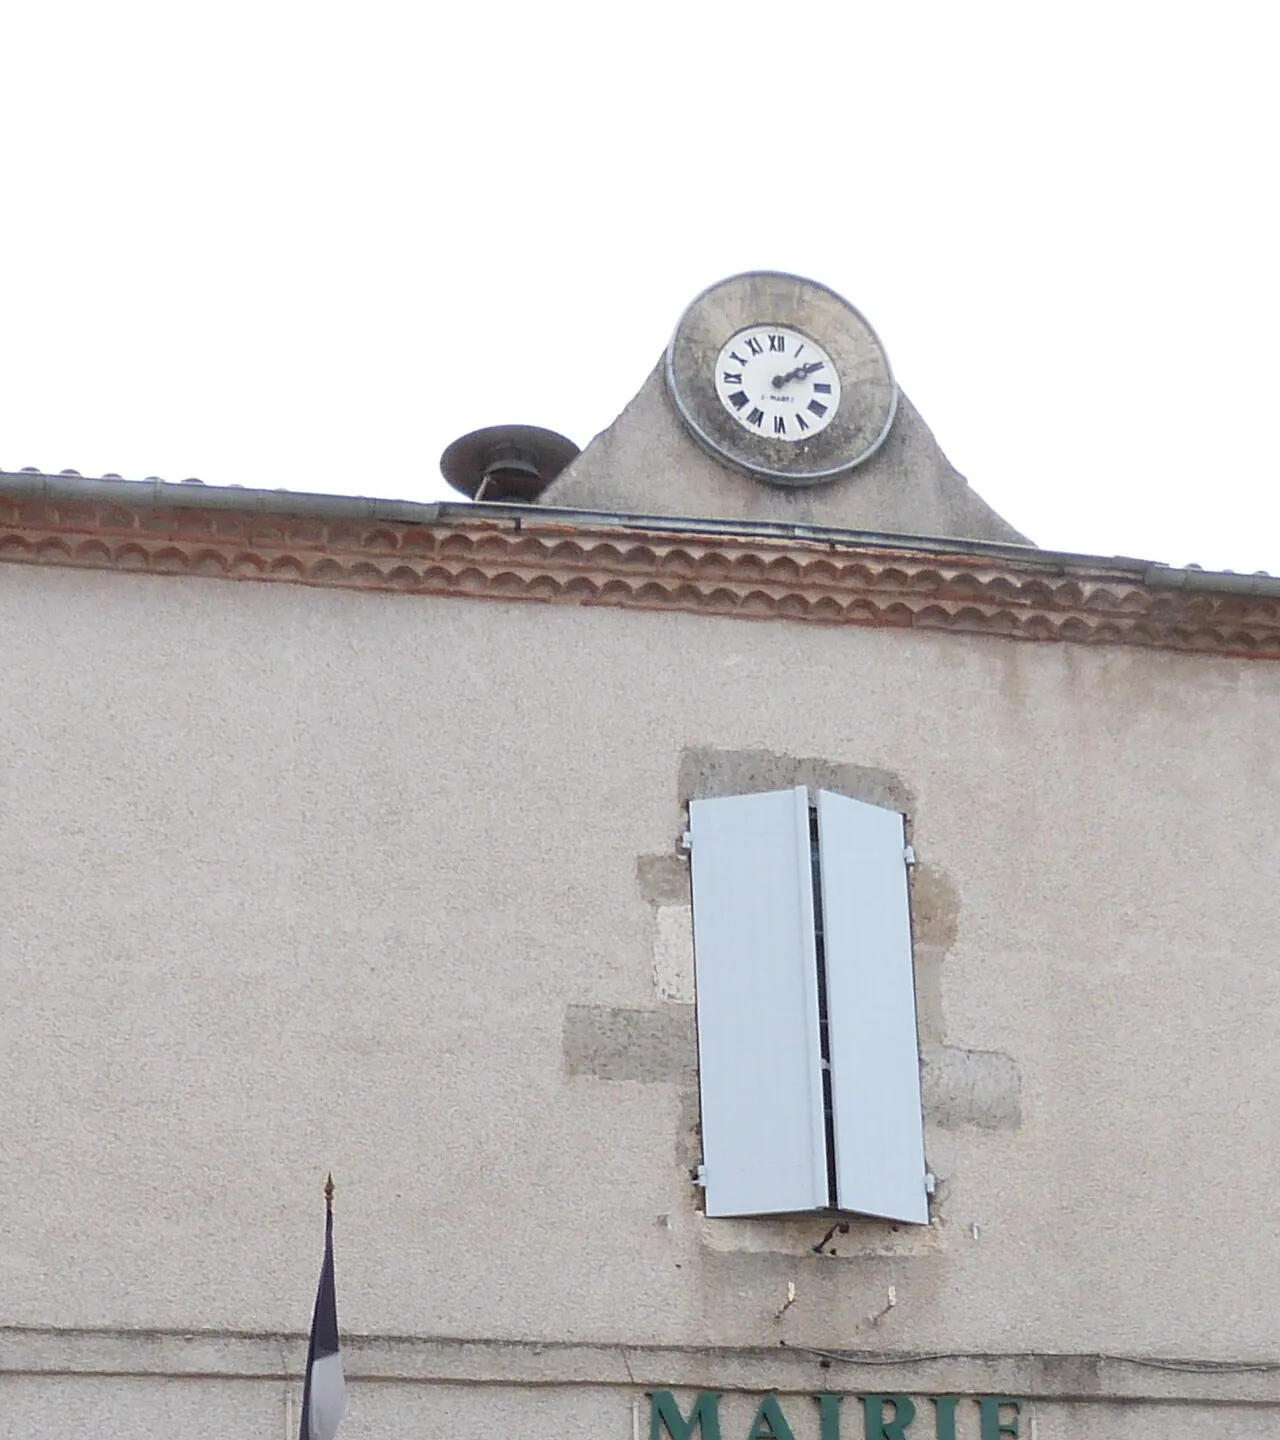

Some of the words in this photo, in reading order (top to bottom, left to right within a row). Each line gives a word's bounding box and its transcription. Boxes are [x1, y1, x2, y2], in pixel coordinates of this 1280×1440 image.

[744, 336, 764, 356] XI
[768, 335, 785, 352] XII
[729, 351, 748, 366] X
[794, 344, 805, 359] I
[723, 371, 742, 384] IX
